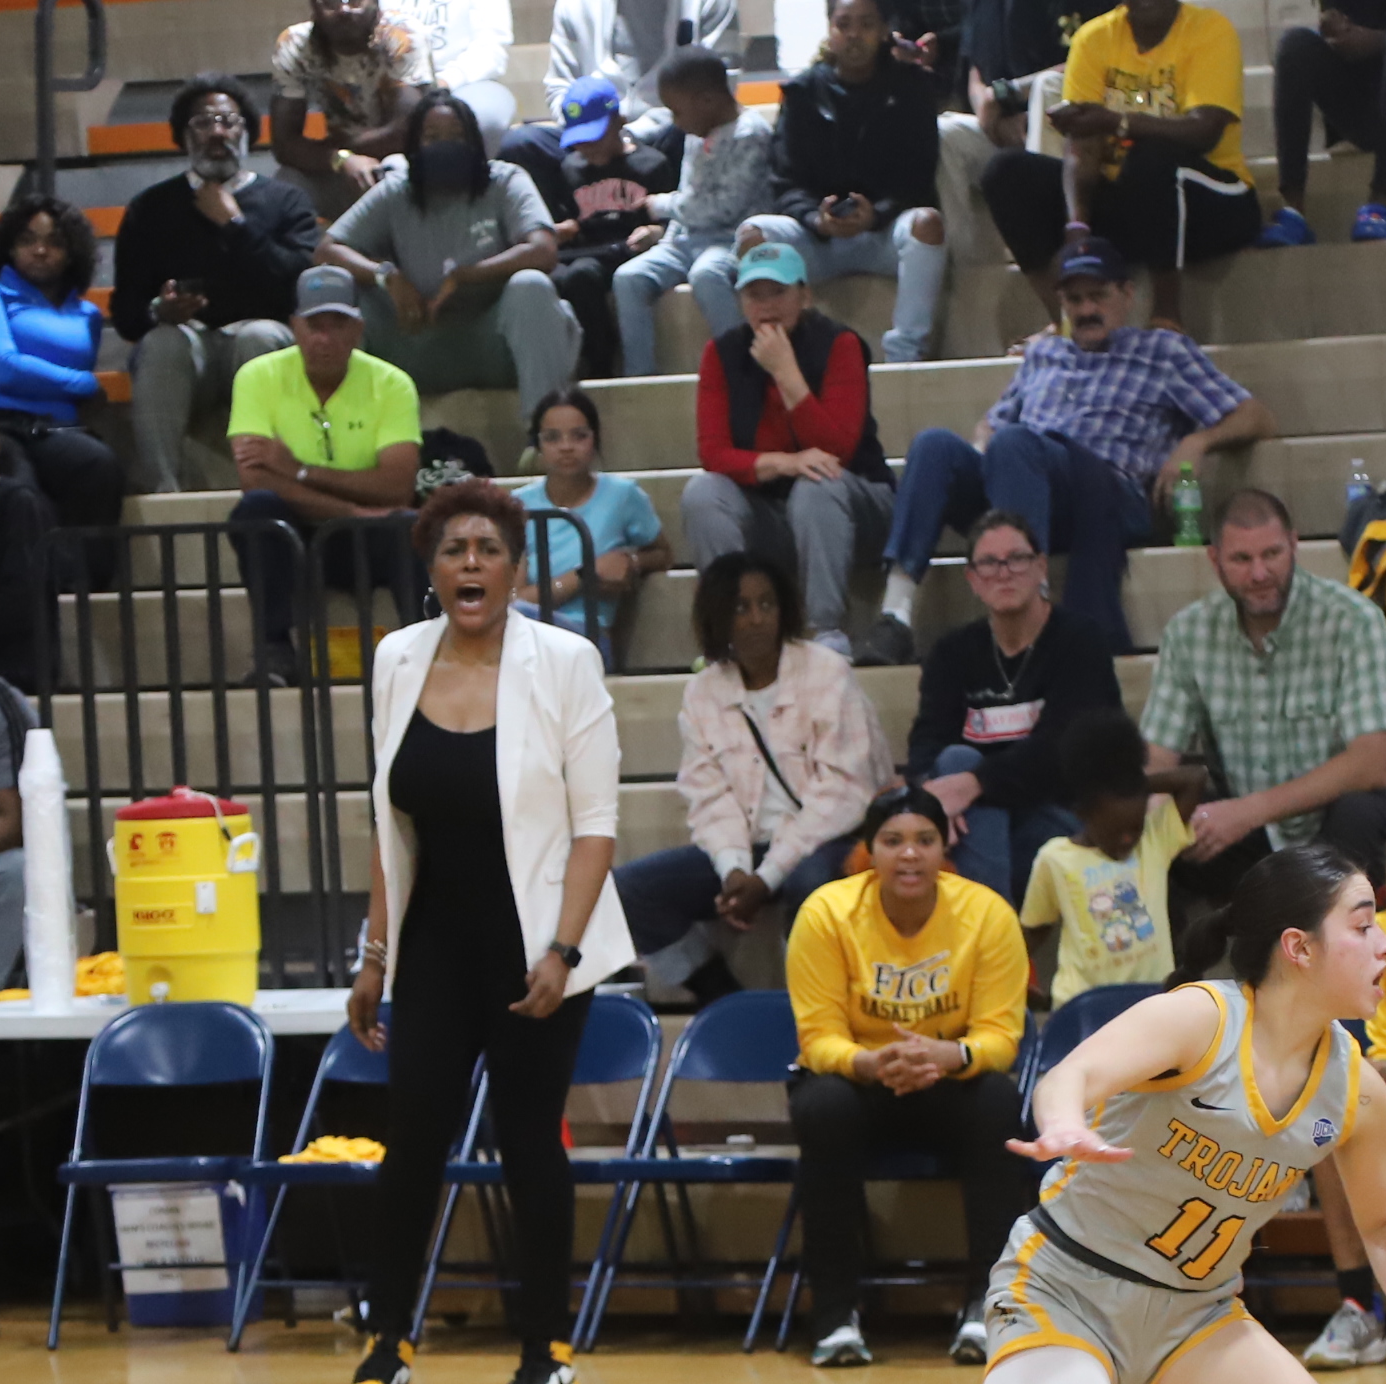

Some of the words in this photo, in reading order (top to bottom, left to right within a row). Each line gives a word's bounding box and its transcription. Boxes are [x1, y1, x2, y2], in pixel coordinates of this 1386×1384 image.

[868, 951, 952, 1003] FTCC
[859, 990, 961, 1023] BASKETBALL
[1144, 1196, 1247, 1281] 11
